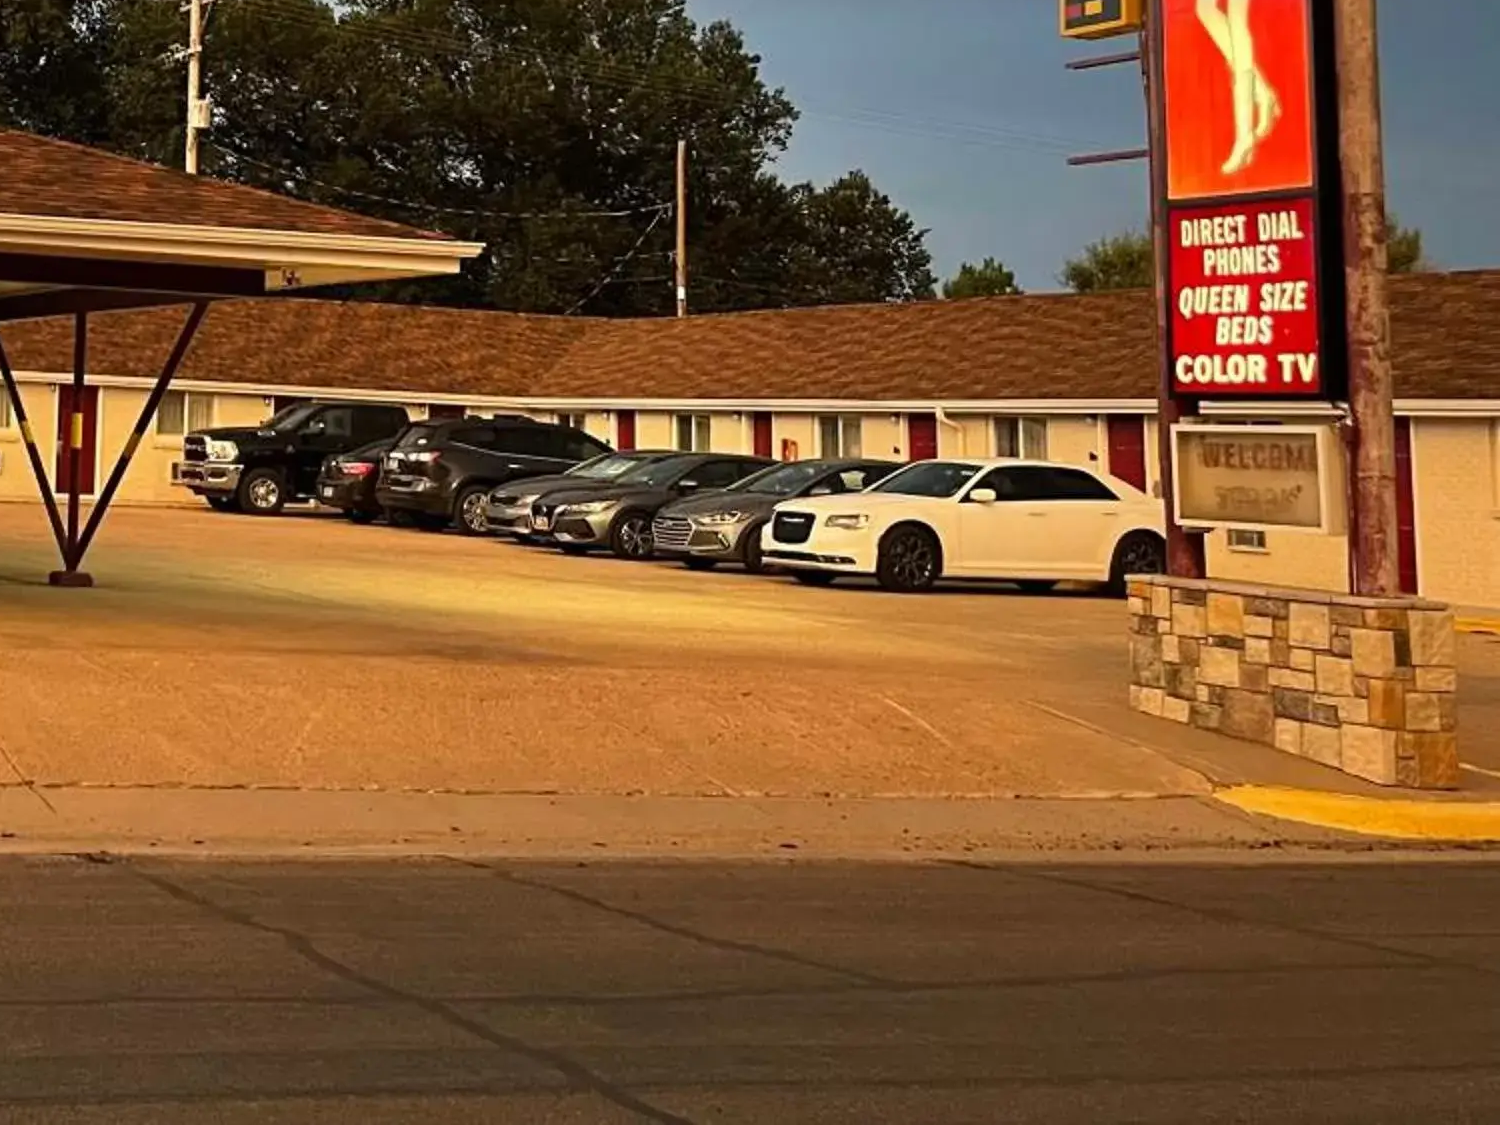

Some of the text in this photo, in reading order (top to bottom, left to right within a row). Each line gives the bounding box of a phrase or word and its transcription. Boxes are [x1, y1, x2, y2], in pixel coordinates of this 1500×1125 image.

[1180, 210, 1304, 247] DIRECT DIAL
[1203, 244, 1281, 276] PHONES
[1178, 280, 1308, 319] QUEEN SIZE
[1215, 315, 1274, 346] BEDS
[1175, 352, 1317, 383] COLOR TV
